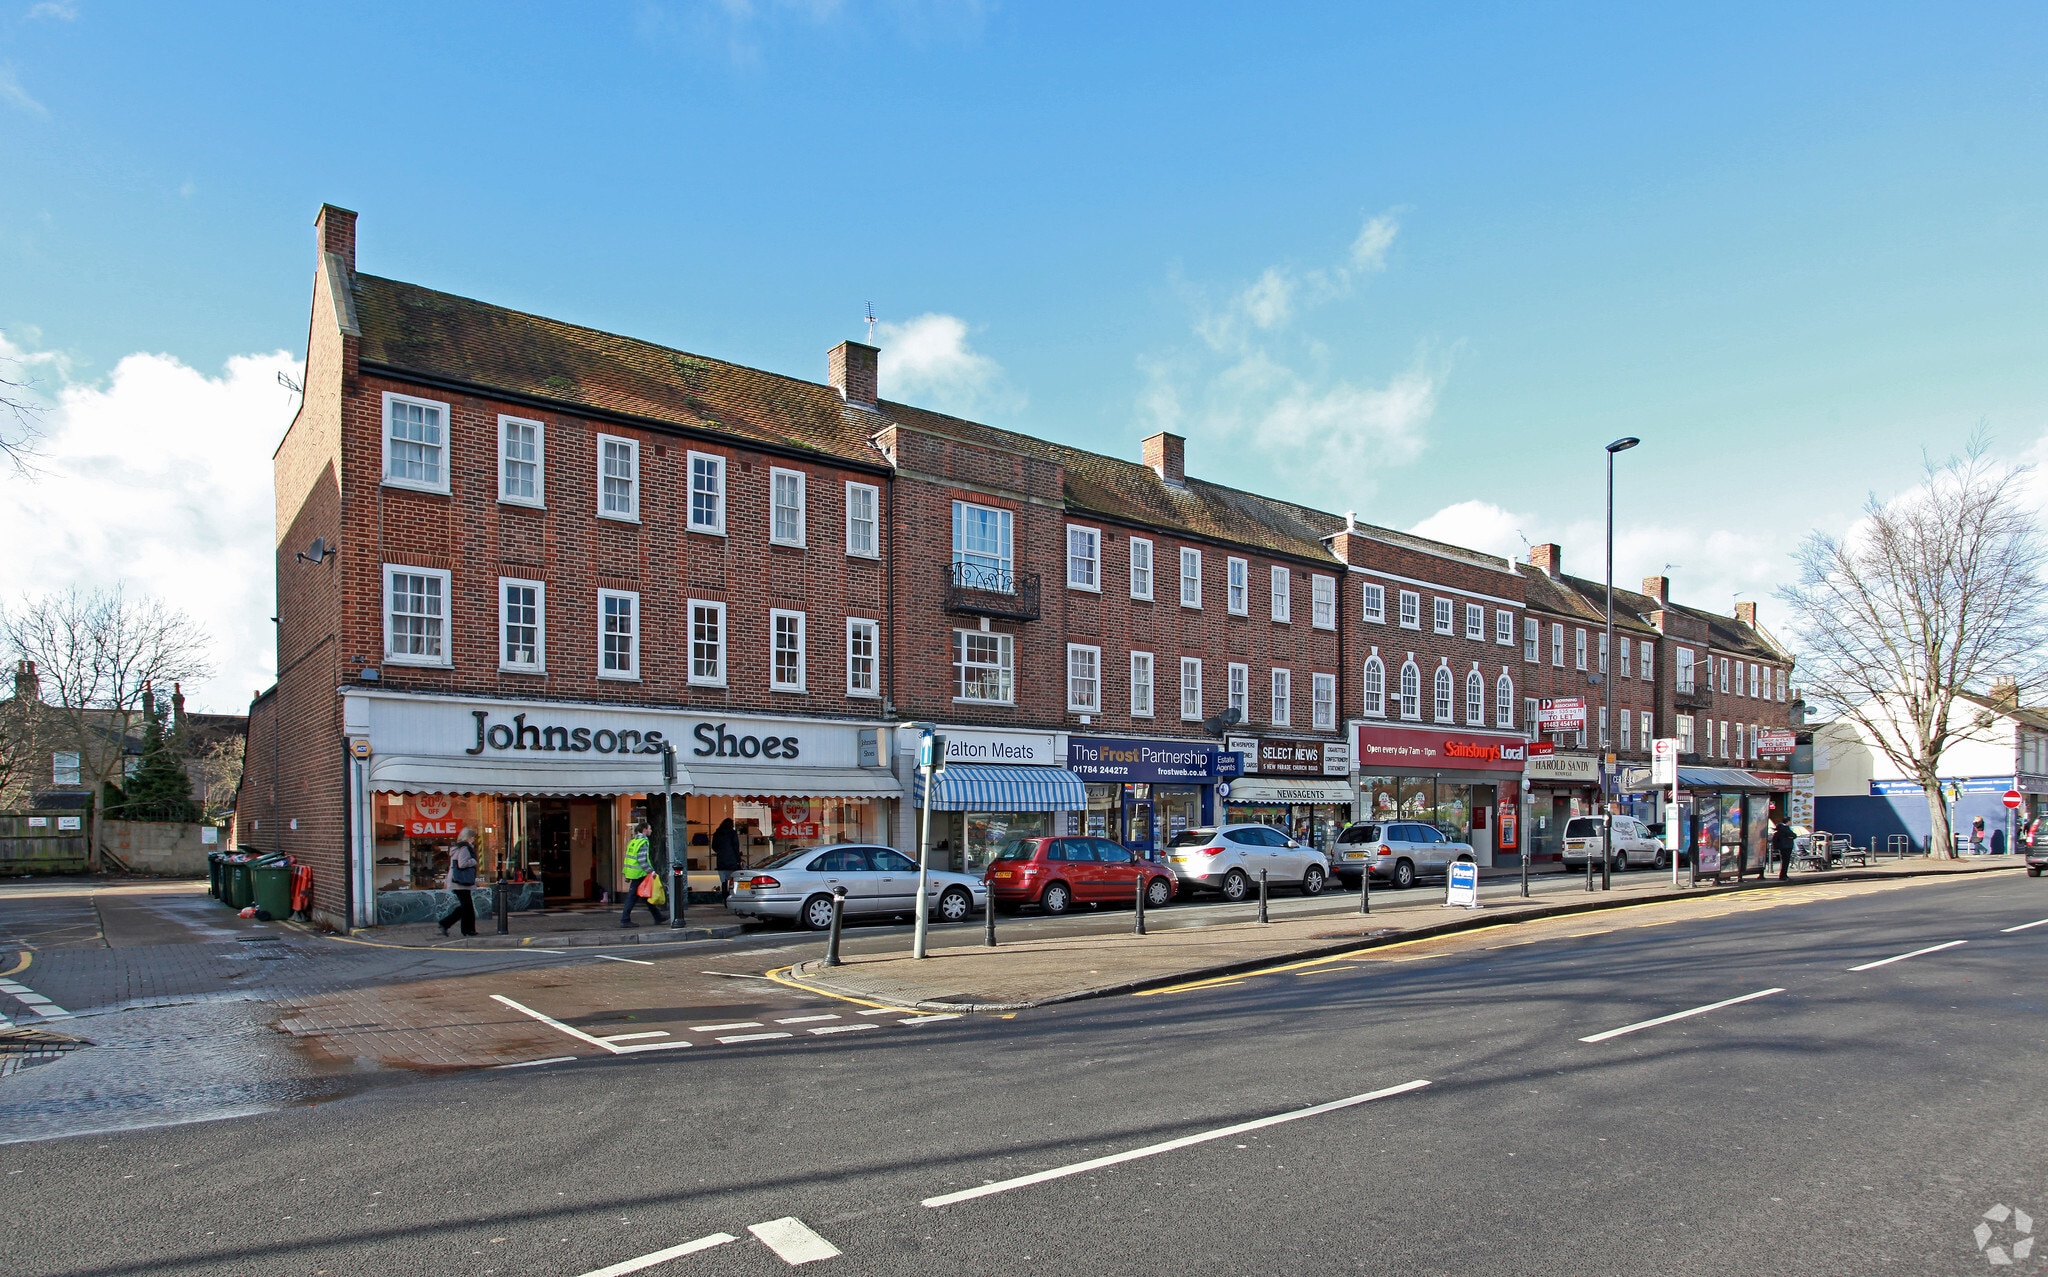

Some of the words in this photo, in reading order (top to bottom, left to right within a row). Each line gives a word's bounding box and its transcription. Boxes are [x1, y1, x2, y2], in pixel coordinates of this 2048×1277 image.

[466, 711, 663, 755] Johnsons
[693, 722, 800, 759] Shoes
[861, 738, 877, 746] Johnsons
[992, 742, 1034, 759] Meats
[1072, 744, 1098, 761] The
[1099, 746, 1139, 763] Frost
[1142, 747, 1208, 768] Partnership
[1262, 746, 1293, 760] SELECT
[1295, 748, 1318, 761] NEWS
[1366, 744, 1381, 754] Open
[1382, 746, 1398, 756] every
[1398, 745, 1408, 756] day
[1409, 746, 1420, 755] 7am
[1424, 747, 1437, 757] 11pm
[1444, 741, 1500, 762] Sainsbury's
[1500, 744, 1524, 761] Local
[1217, 755, 1235, 764] Estate
[1072, 765, 1098, 773] 01784
[1099, 766, 1129, 775] 244272
[1216, 763, 1236, 772] Agents
[1535, 760, 1566, 771] HAROLD
[1568, 760, 1590, 772] SANDY
[1157, 767, 1208, 777] frostweb.co.uk
[1277, 789, 1325, 799] NEWSAGENTS
[421, 796, 447, 807] 50%
[786, 804, 806, 815] 50%
[412, 822, 457, 835] SALE
[781, 825, 814, 836] SALE
